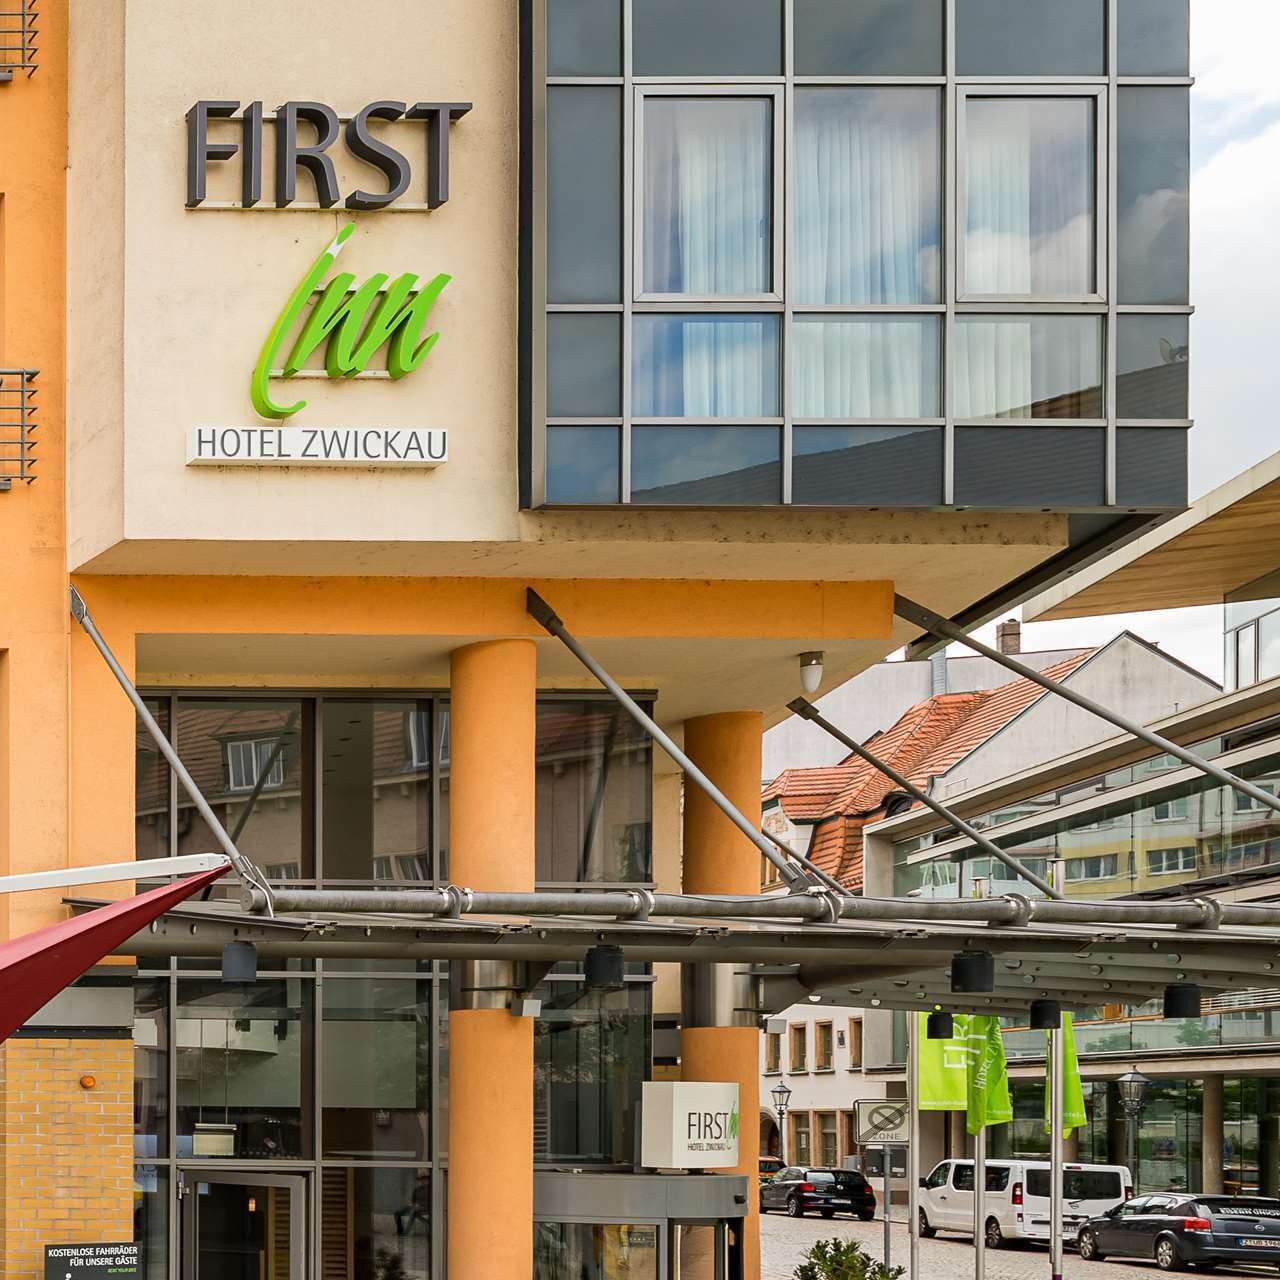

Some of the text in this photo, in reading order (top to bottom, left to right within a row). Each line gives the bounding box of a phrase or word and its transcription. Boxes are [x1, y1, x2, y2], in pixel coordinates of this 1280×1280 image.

[186, 100, 473, 209] FIRST
[197, 428, 447, 460] HOTEL ZWICKAU
[687, 1112, 729, 1140] FIRST
[872, 1131, 901, 1140] ZONE
[687, 1143, 705, 1151] HOTEL
[48, 1245, 138, 1257] KOSTENLOSE FAHRRÄDER
[69, 1255, 138, 1266] FÜR UNSERE GÄSTE
